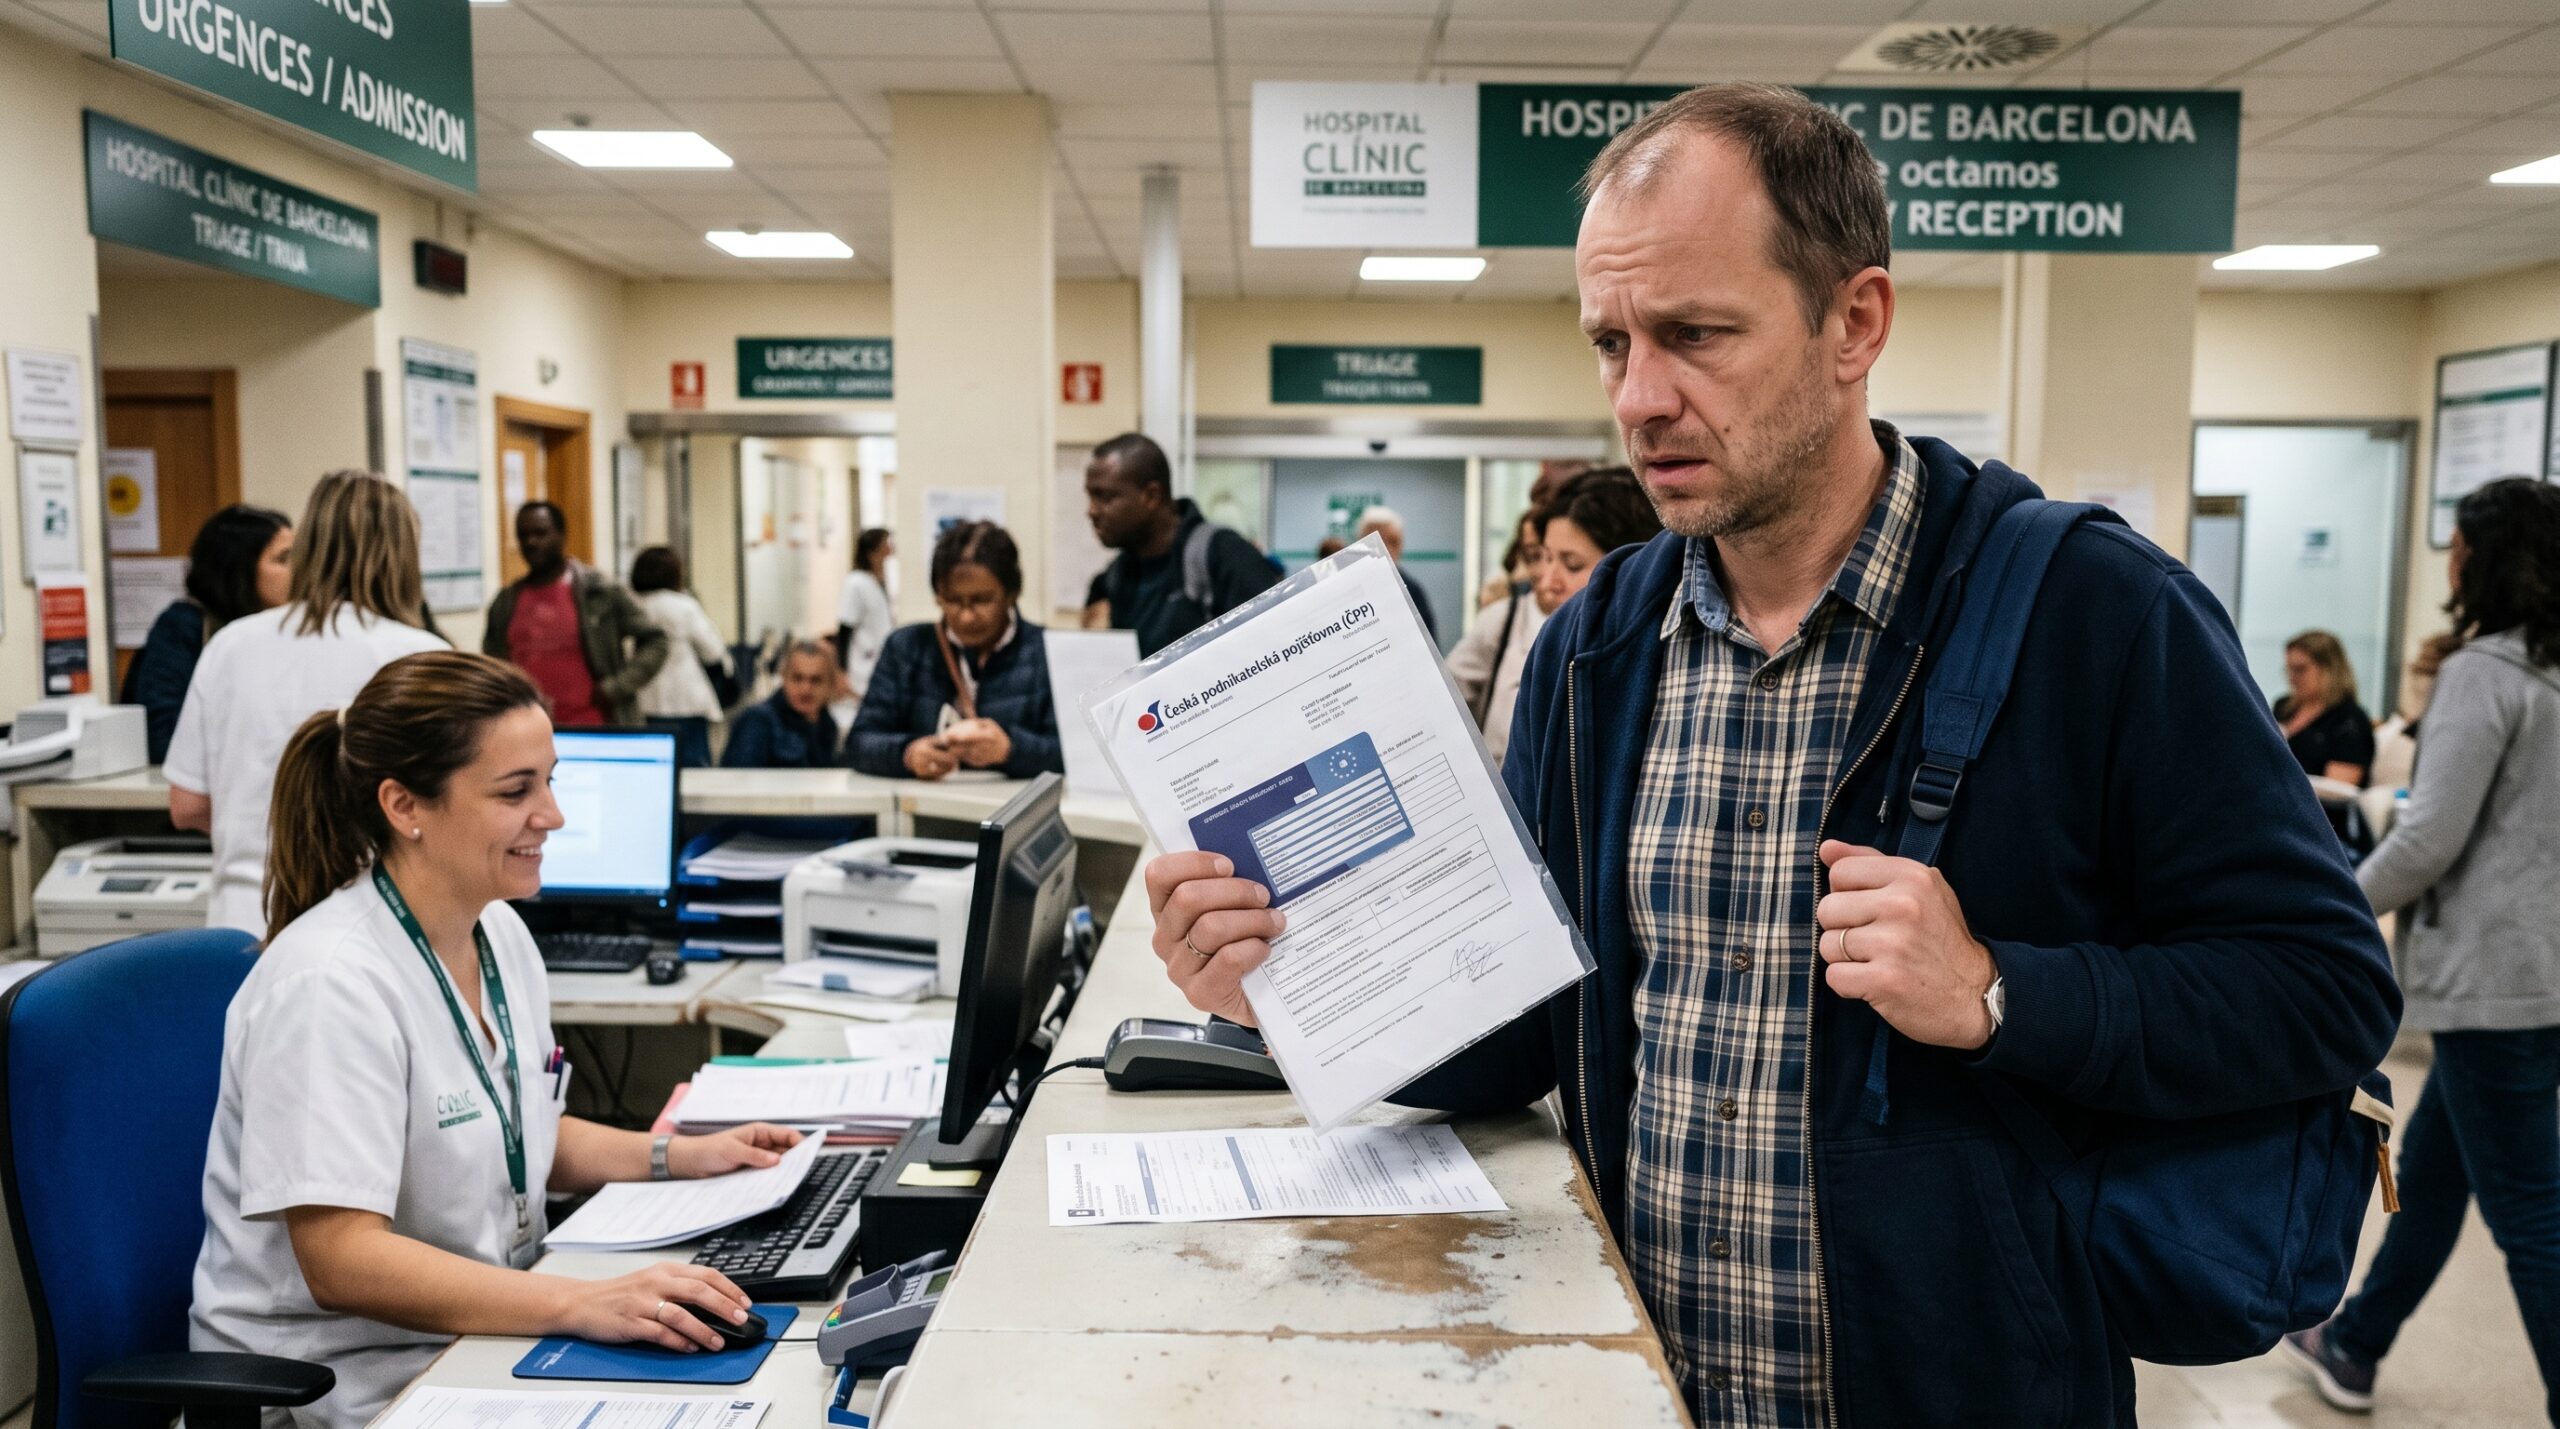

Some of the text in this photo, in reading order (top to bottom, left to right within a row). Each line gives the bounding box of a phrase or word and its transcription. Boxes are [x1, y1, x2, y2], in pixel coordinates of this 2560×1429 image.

[138, 0, 467, 162] URGENCES / ADMISSION
[1303, 111, 1427, 134] HOSPITAL
[1879, 102, 1933, 141] DE
[1947, 104, 2196, 143] BARCELONA
[1302, 134, 1427, 175] CLÍNIC
[1900, 155, 2060, 189] octamos
[106, 137, 201, 199] HOSPITAL
[260, 190, 283, 226] DE
[191, 212, 252, 259] TRIAGE
[1907, 200, 2124, 237] RECEPTION
[764, 346, 891, 371] URGENCES
[1335, 352, 1418, 376] TRIAGE
[1164, 693, 1200, 719] Česká
[1201, 650, 1282, 704] podnikatelská
[1342, 602, 1375, 630] (ČPP)
